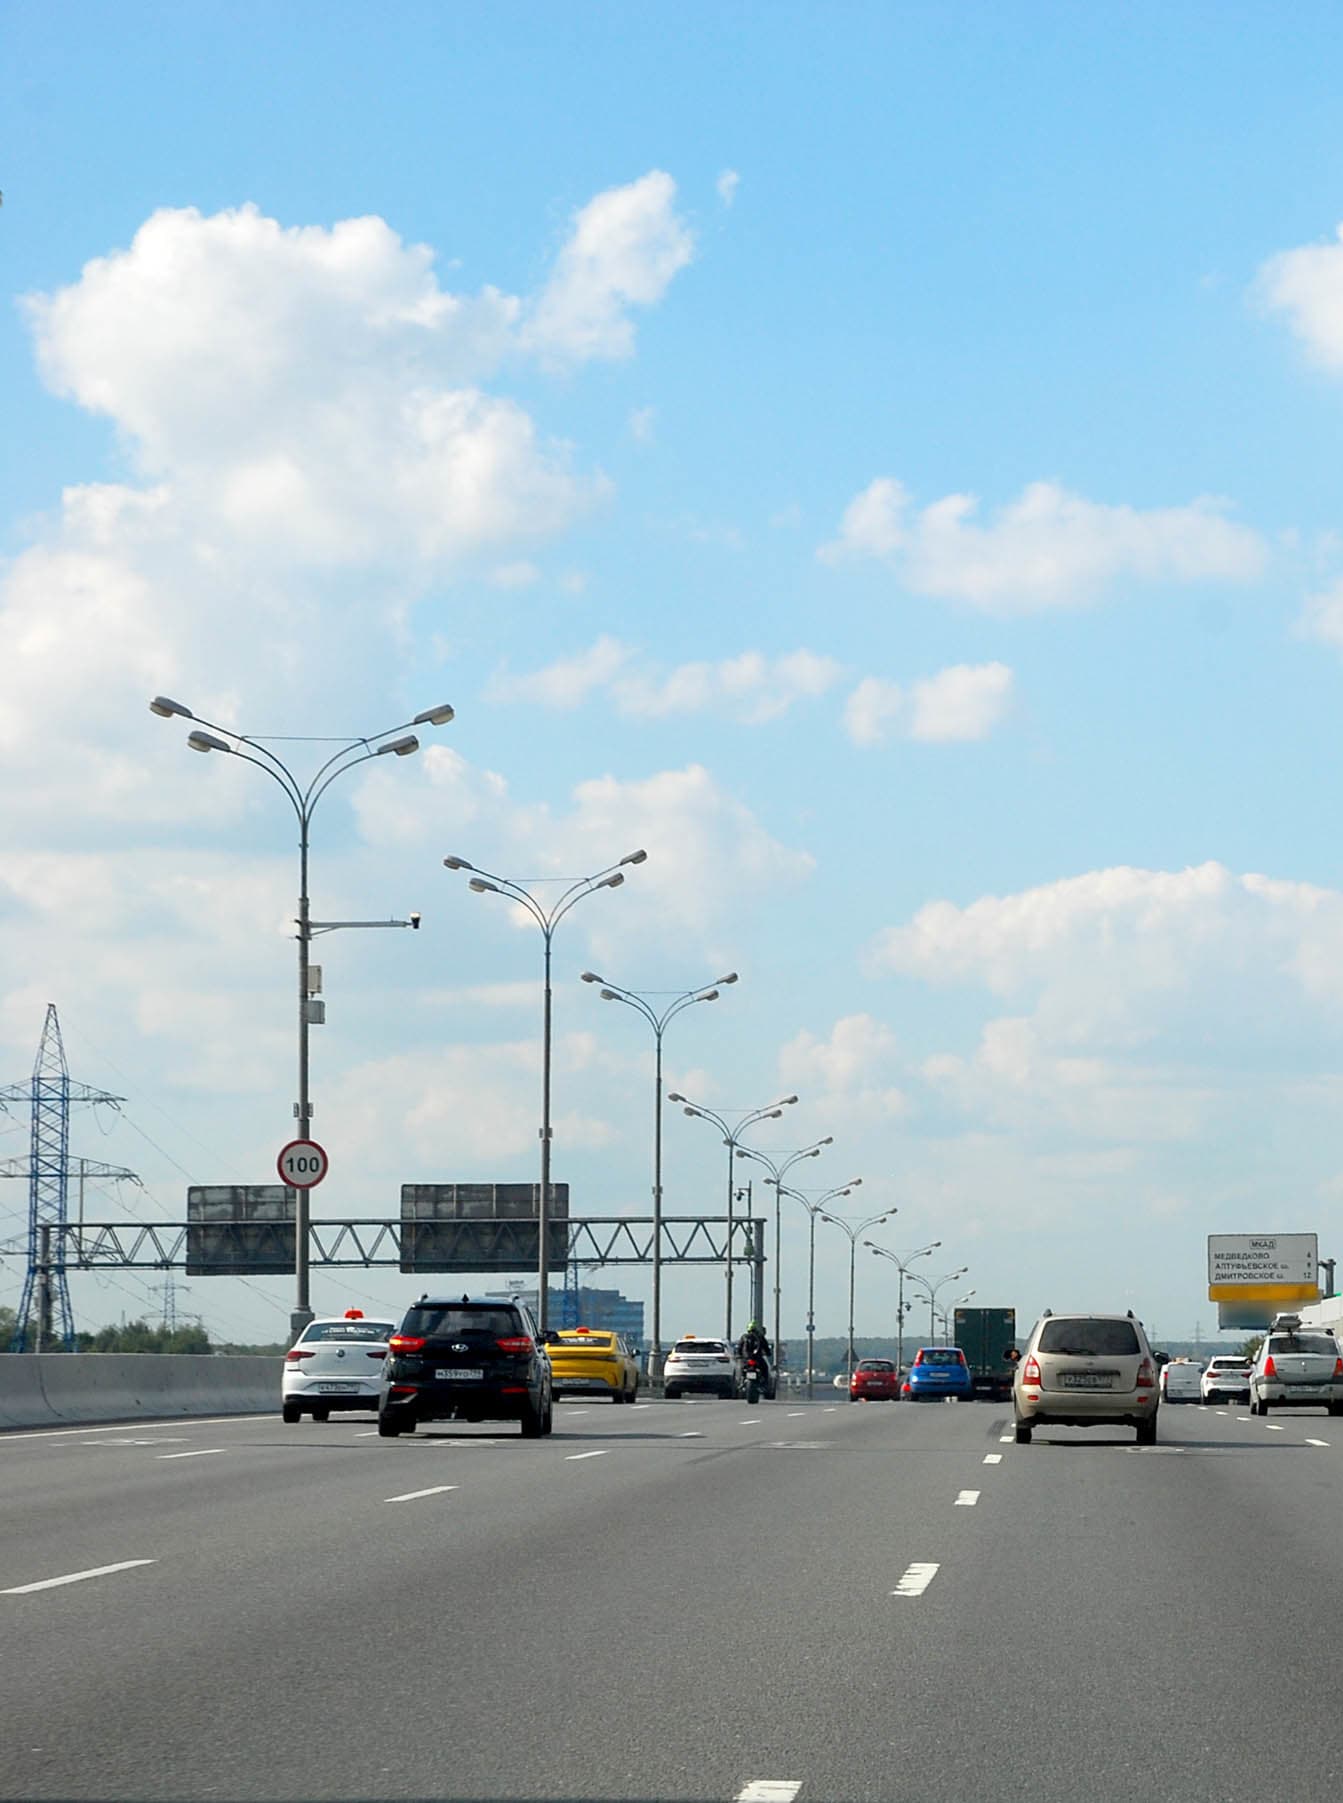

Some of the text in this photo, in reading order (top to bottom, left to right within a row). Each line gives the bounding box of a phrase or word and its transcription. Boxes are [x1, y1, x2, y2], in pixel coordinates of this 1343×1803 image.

[286, 1156, 319, 1173] 100
[1251, 1241, 1275, 1249] МКАД
[1214, 1252, 1270, 1260] МЕДВЕДКОВО
[1215, 1262, 1279, 1270] АЛТУФЬЕВСКОЕ
[1215, 1272, 1275, 1281] ДМИТРОВСКОЕ
